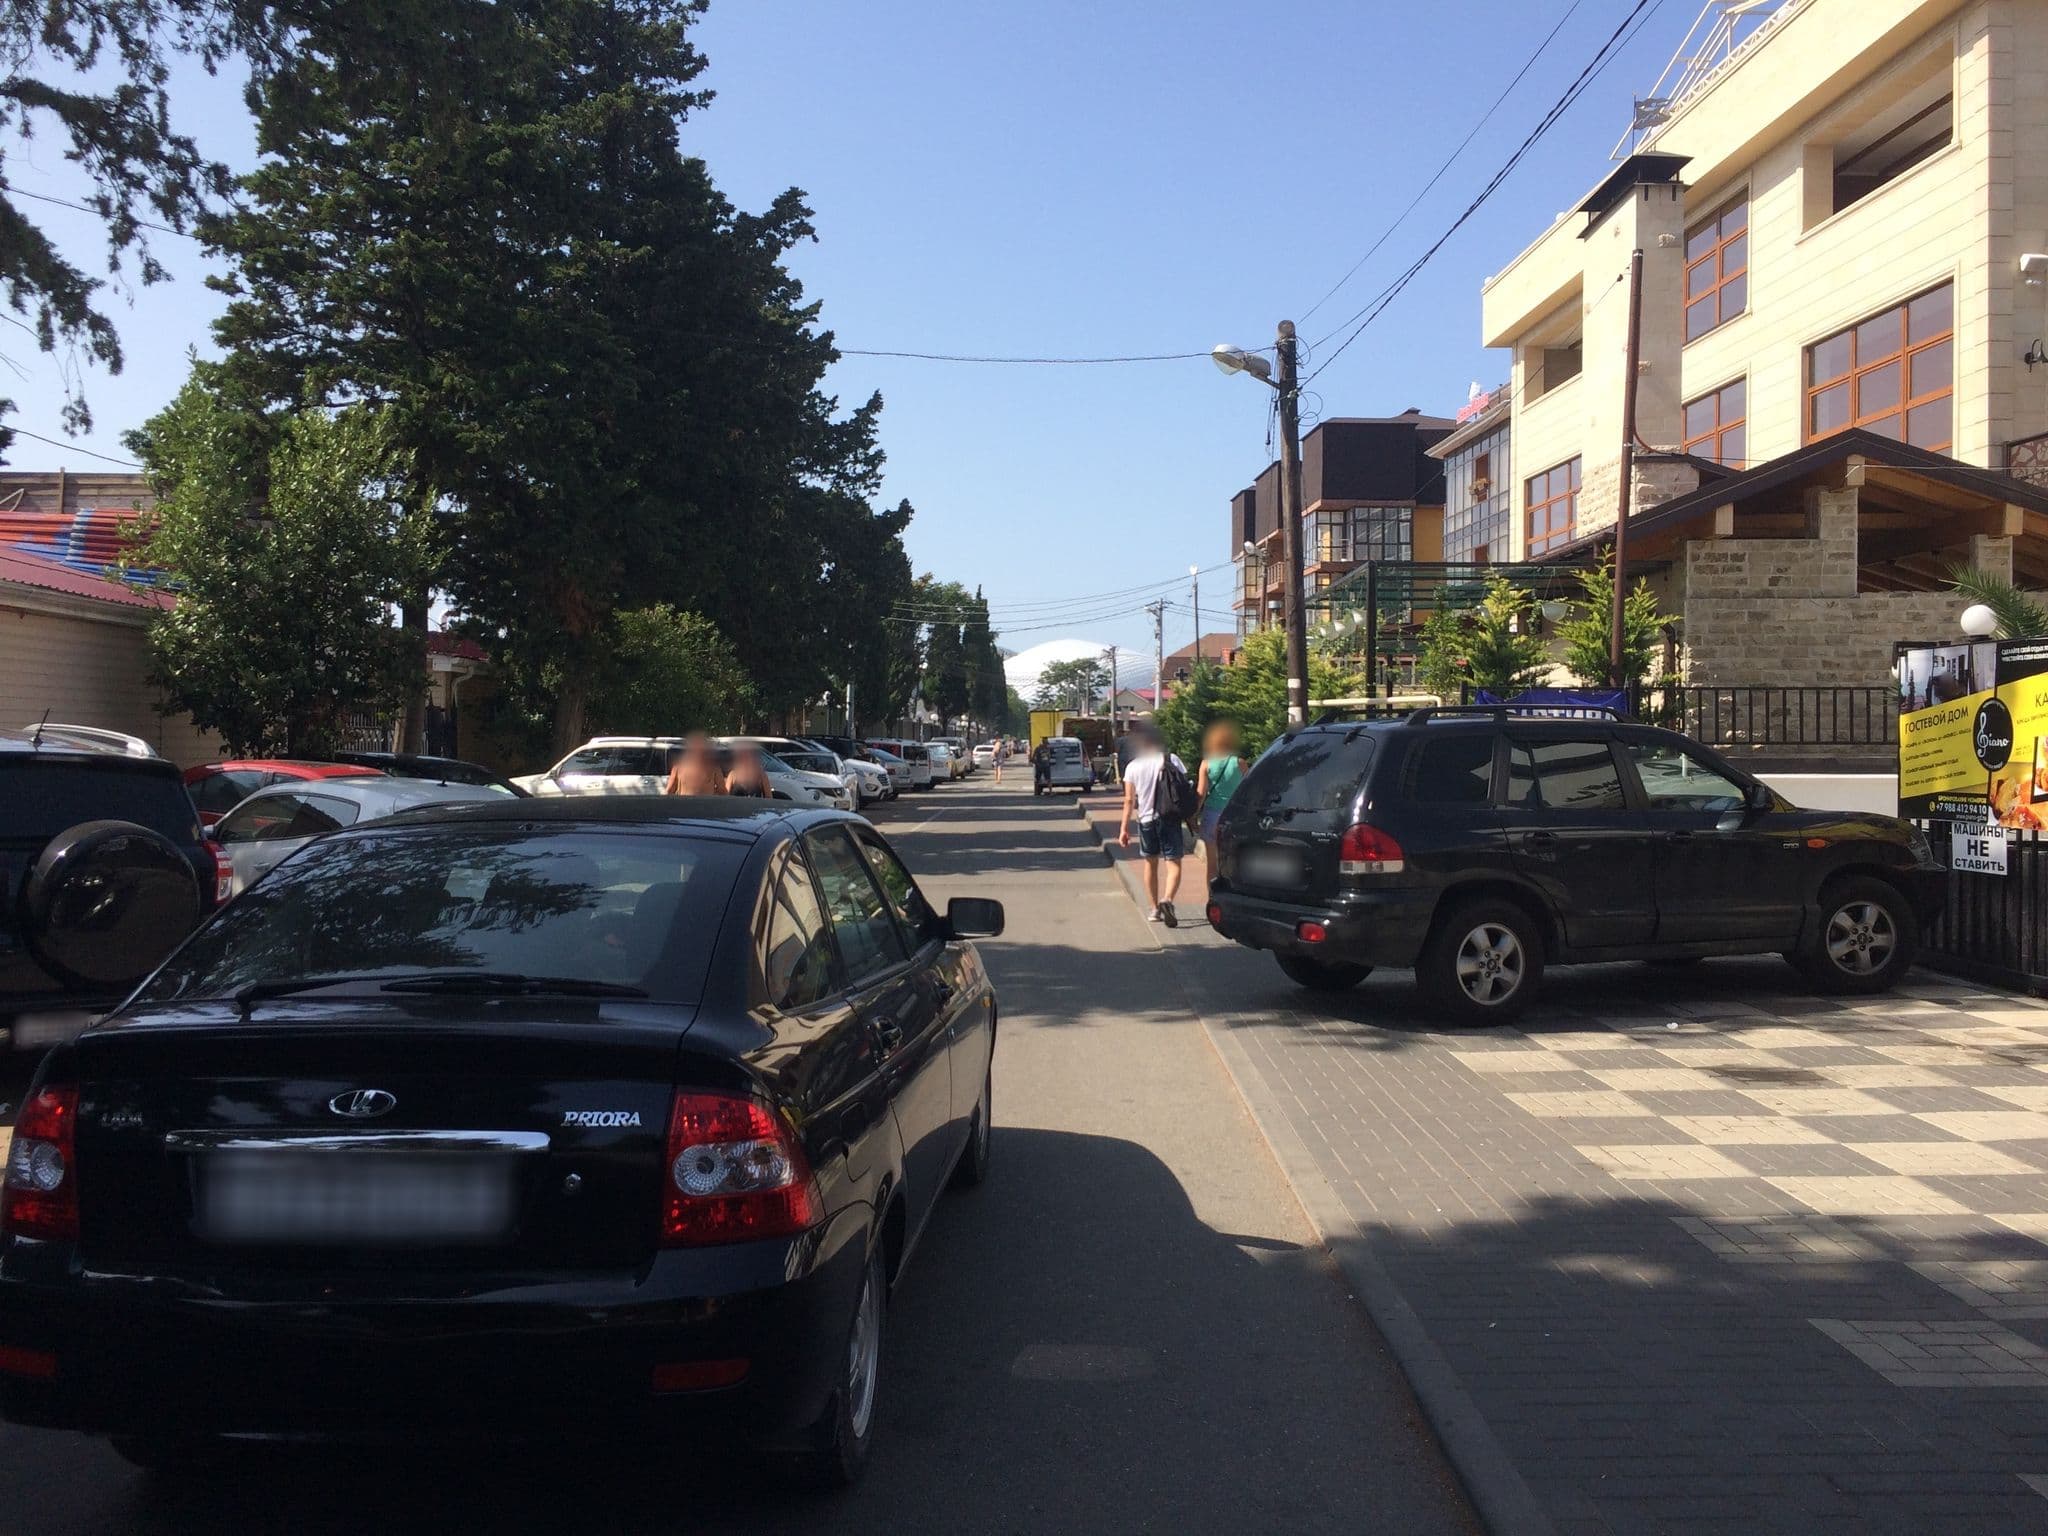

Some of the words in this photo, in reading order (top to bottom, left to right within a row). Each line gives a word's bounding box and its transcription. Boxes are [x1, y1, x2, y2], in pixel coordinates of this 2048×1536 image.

[1905, 710, 1946, 734] ГОСТЕВОЙ
[1948, 706, 1969, 724] ДОМ
[1957, 804, 1968, 813] 412
[1969, 804, 1978, 814] 94
[1979, 805, 1987, 815] 10
[1954, 823, 2004, 838] МАШИНЫ
[1967, 839, 1990, 857] НЕ
[1954, 858, 2005, 872] СТАВИТЬ
[560, 1111, 642, 1127] PRIORA
